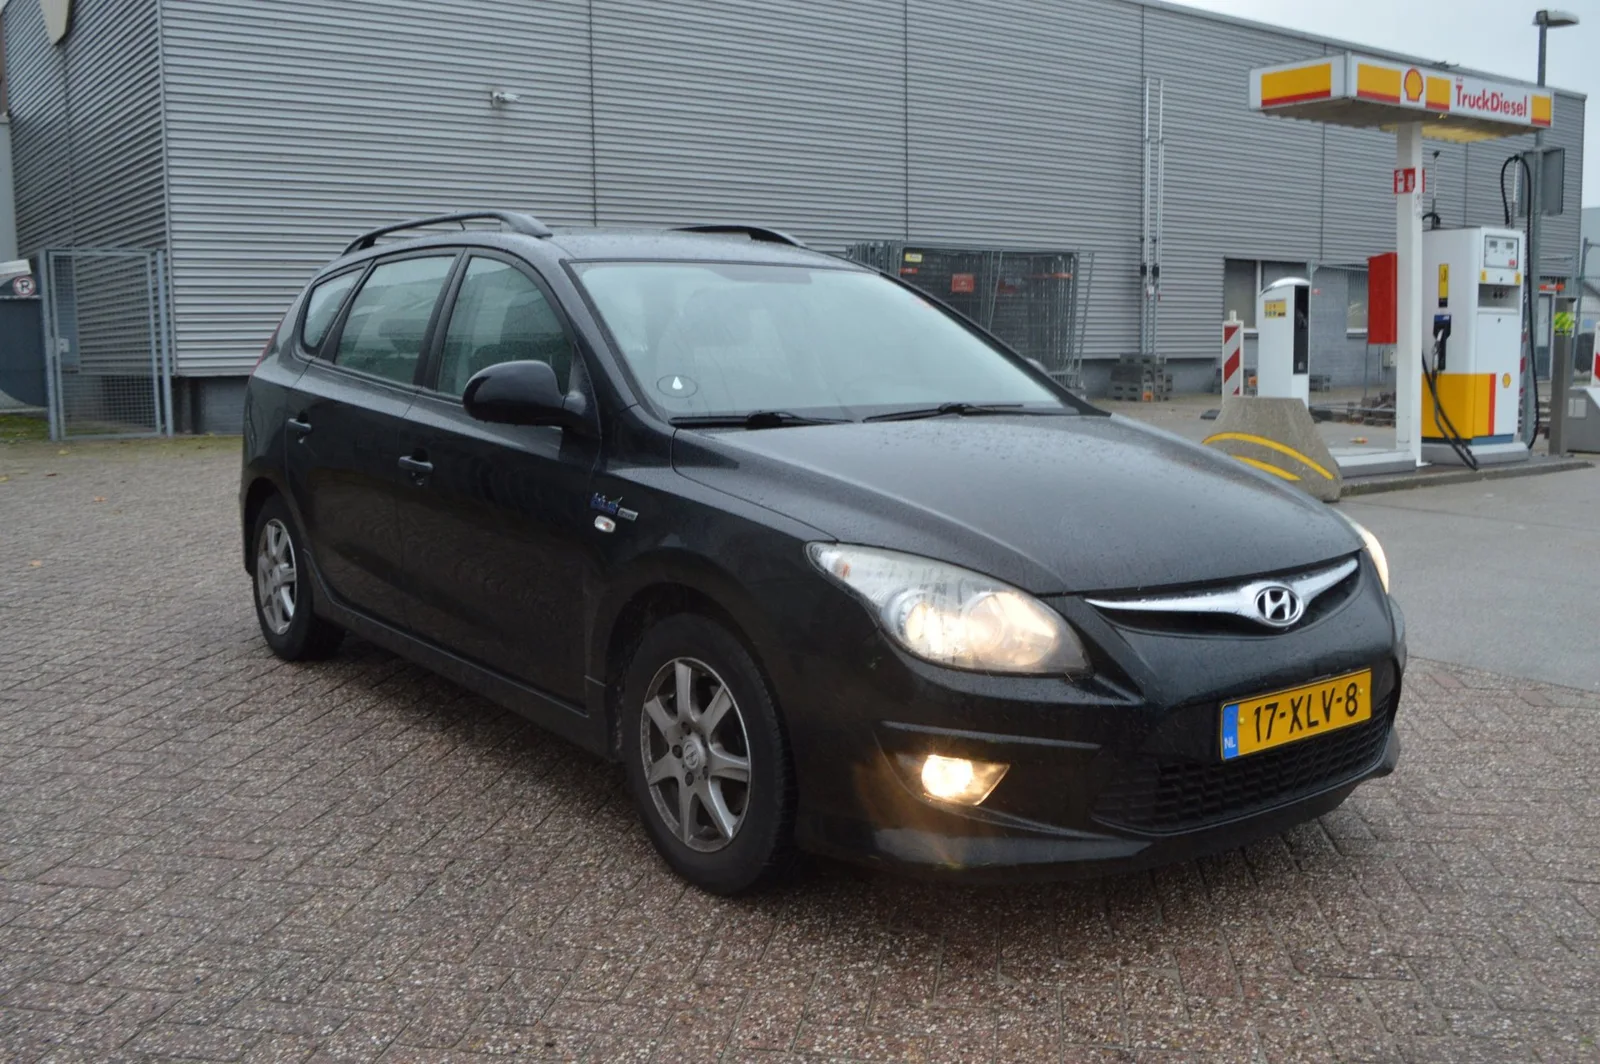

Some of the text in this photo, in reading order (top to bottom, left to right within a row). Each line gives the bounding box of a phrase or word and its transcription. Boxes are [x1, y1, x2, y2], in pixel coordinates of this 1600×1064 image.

[1456, 84, 1528, 117] TruckDiesel
[1253, 682, 1359, 743] 17-XLV-8
[1223, 736, 1237, 749] NL
